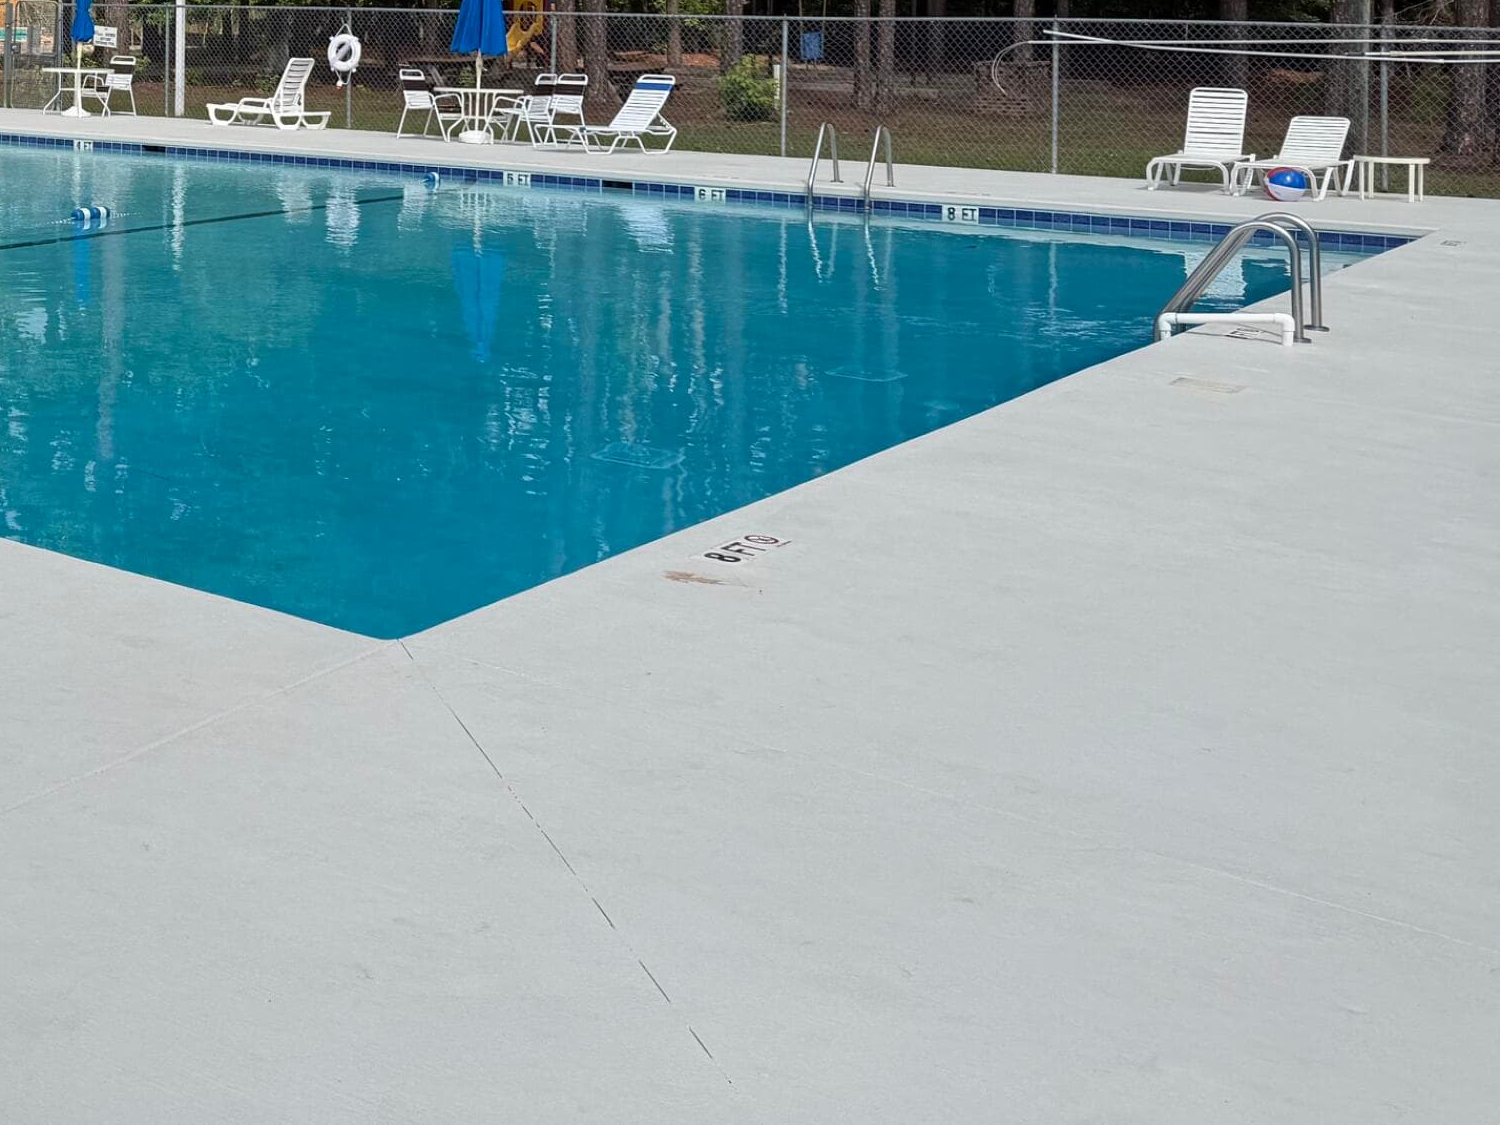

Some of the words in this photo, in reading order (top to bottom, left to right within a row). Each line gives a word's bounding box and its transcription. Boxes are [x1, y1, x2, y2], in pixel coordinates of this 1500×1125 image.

[699, 188, 706, 200] 6
[711, 189, 725, 201] FT
[947, 207, 956, 221] 8
[961, 207, 977, 221] FT
[721, 542, 766, 556] FT
[704, 552, 741, 562] 8
